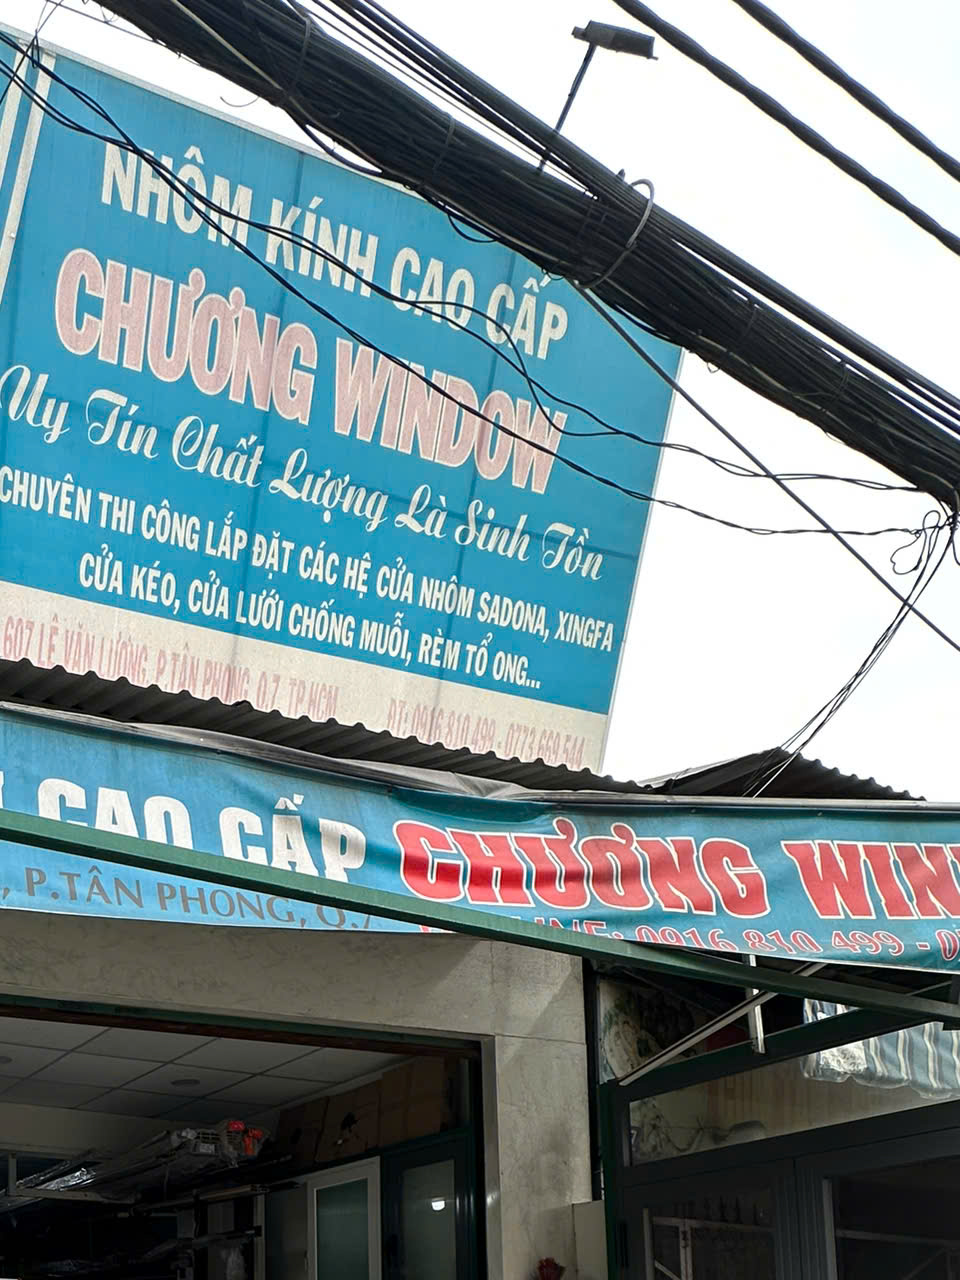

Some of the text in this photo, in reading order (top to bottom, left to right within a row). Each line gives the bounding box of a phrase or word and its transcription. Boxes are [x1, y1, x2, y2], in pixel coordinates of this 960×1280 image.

[101, 142, 568, 361] NHÔM KÍNH CAO CẤP
[55, 247, 567, 495] CHƯƠNG WINDOW
[84, 391, 161, 460] Tín
[171, 414, 263, 489] Chất
[269, 447, 390, 540] Lượng
[395, 486, 448, 540] Là
[454, 500, 531, 562] Sinh
[540, 521, 604, 582] Tồn
[79, 541, 542, 690] CỬA KÉO, CỬA LƯỚI CHỐNG MUỖI, RÈM TỔ ONG...
[99, 491, 135, 537] THI
[141, 493, 200, 554] CÔNG
[205, 504, 248, 563] LẮP
[251, 531, 295, 579] ĐẶT
[298, 534, 339, 585] CÁC
[342, 550, 370, 598] HỆ
[376, 547, 415, 603] CỬA
[419, 570, 474, 620] NHÔM
[478, 593, 551, 640] SADONA,
[554, 609, 616, 652] XINGFA
[2, 614, 35, 662] 607
[38, 613, 59, 668] LÊ
[64, 621, 96, 676] VĂN
[445, 710, 471, 749] 810
[26, 865, 145, 910] P.TÂN
[157, 882, 307, 927] PHONG,
[219, 793, 367, 884] CẤP
[393, 816, 772, 919] CHƯƠNG
[783, 839, 960, 921] WIN
[741, 929, 823, 955] 810
[831, 930, 905, 956] 499
